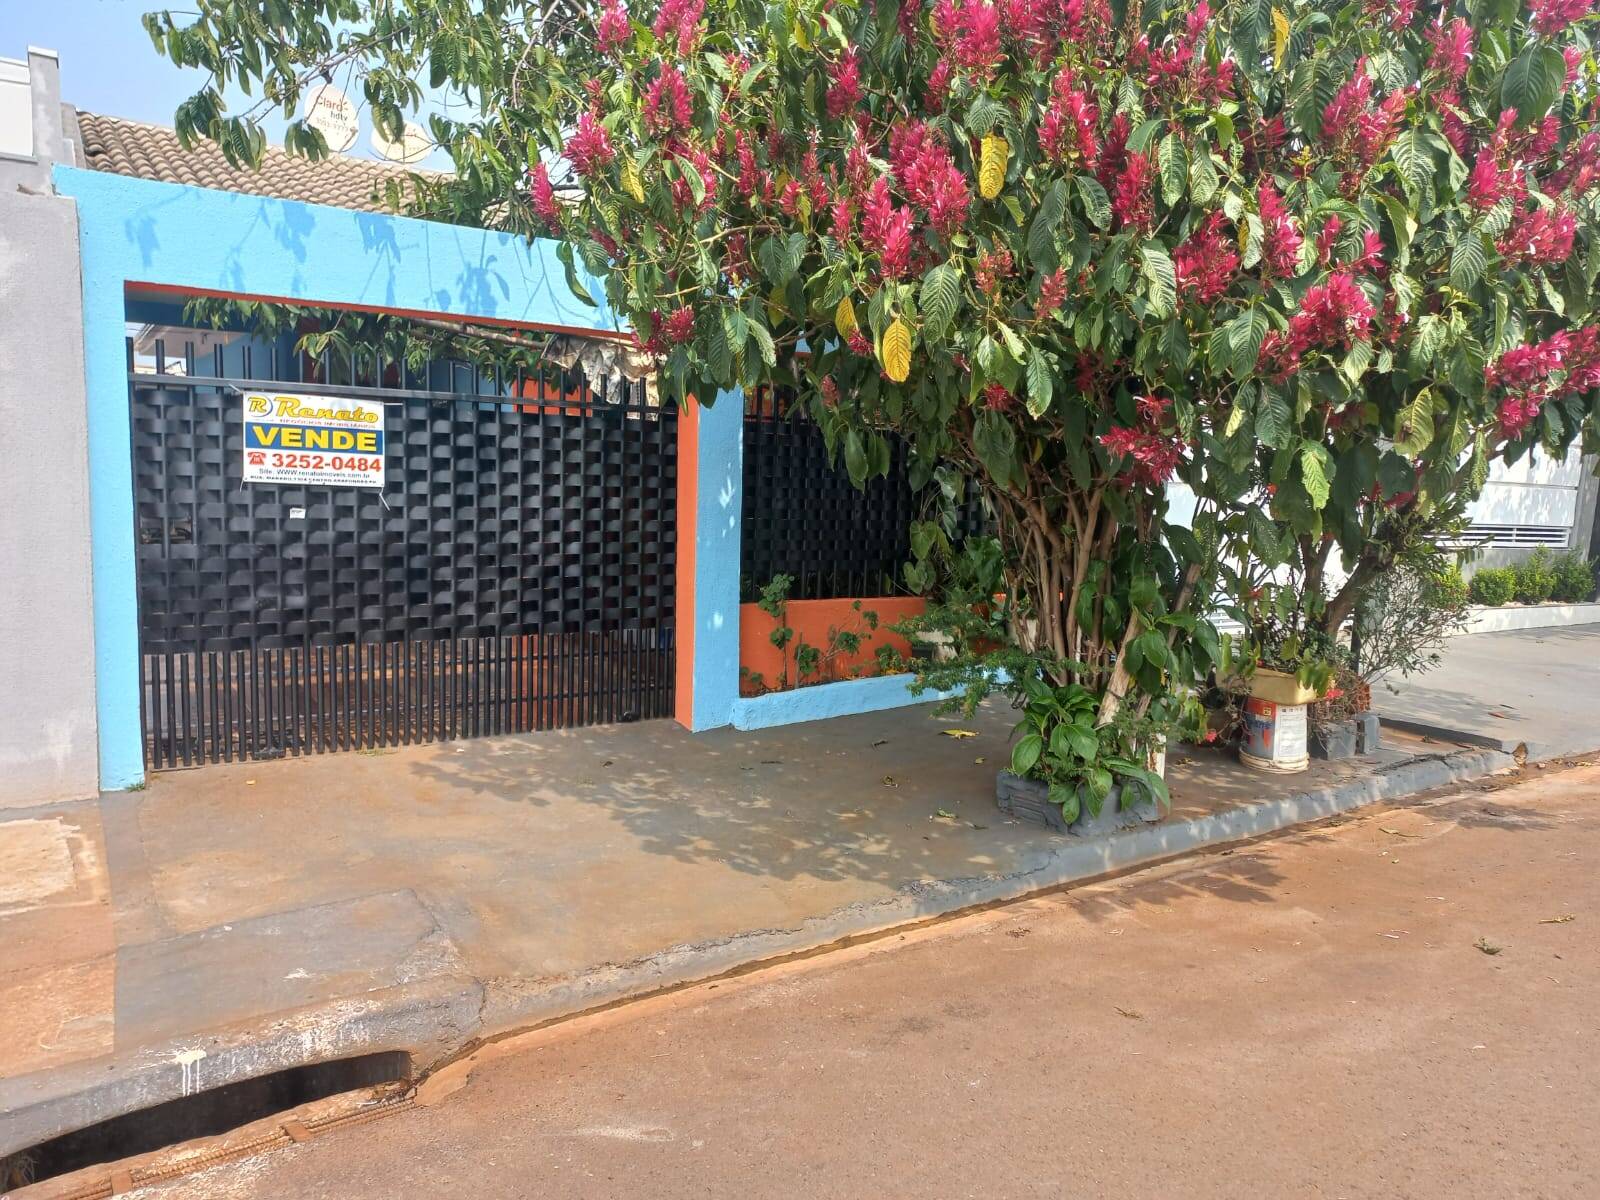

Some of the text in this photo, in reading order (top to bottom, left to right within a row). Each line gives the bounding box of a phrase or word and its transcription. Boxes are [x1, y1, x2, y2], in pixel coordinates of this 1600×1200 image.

[273, 396, 379, 424] Renato
[252, 425, 377, 452] VENDE
[271, 453, 382, 473] 3252-0484
